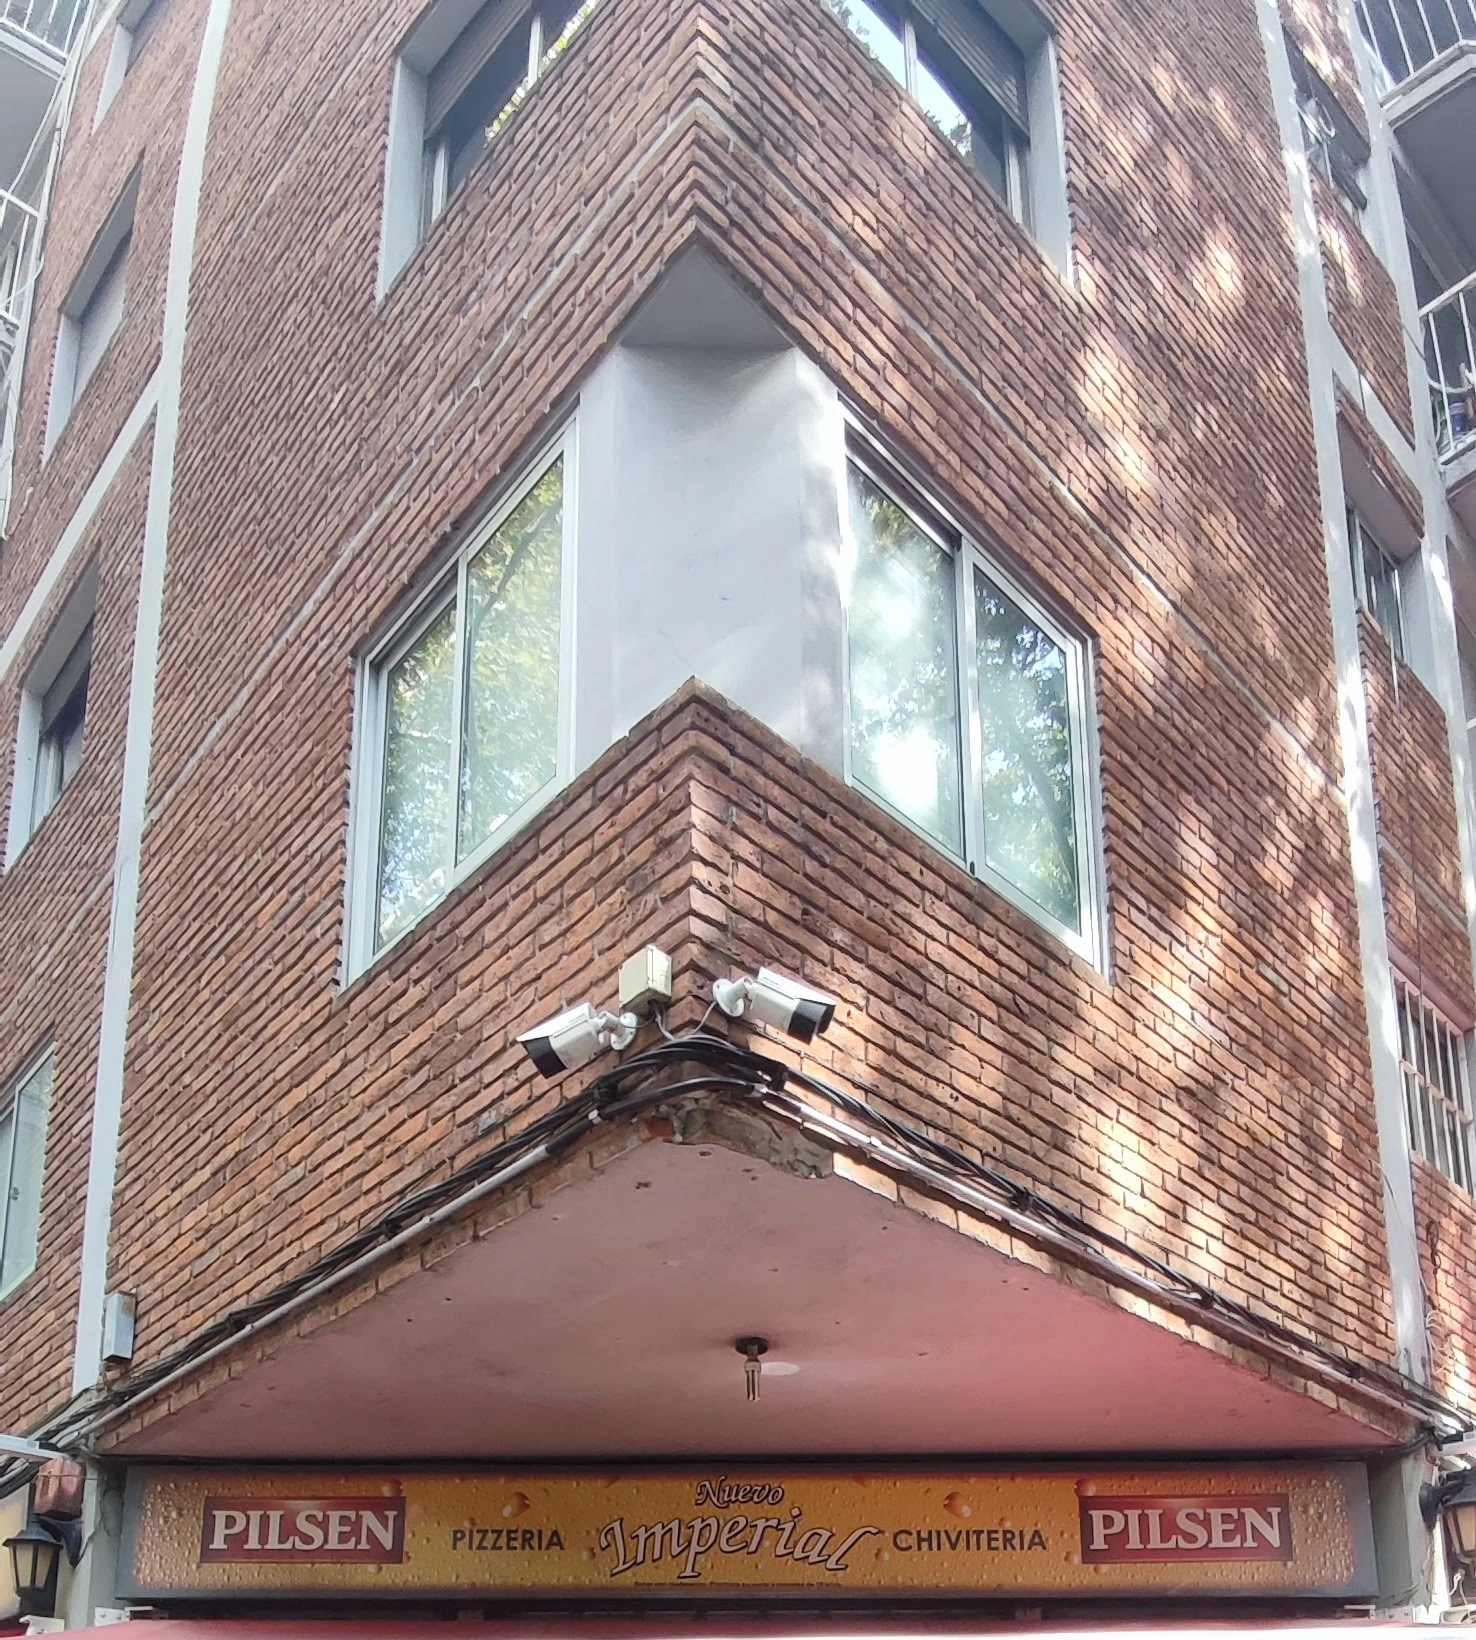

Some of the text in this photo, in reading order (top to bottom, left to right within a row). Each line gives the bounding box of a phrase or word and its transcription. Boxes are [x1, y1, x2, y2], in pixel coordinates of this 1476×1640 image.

[695, 1476, 784, 1508] Nuevo
[208, 1508, 398, 1552] PILSEN
[452, 1528, 564, 1552] PIZZERIA
[600, 1506, 880, 1580] Imperial
[893, 1528, 1048, 1552] CHIVITERIA
[1088, 1507, 1282, 1550] PILSEN
